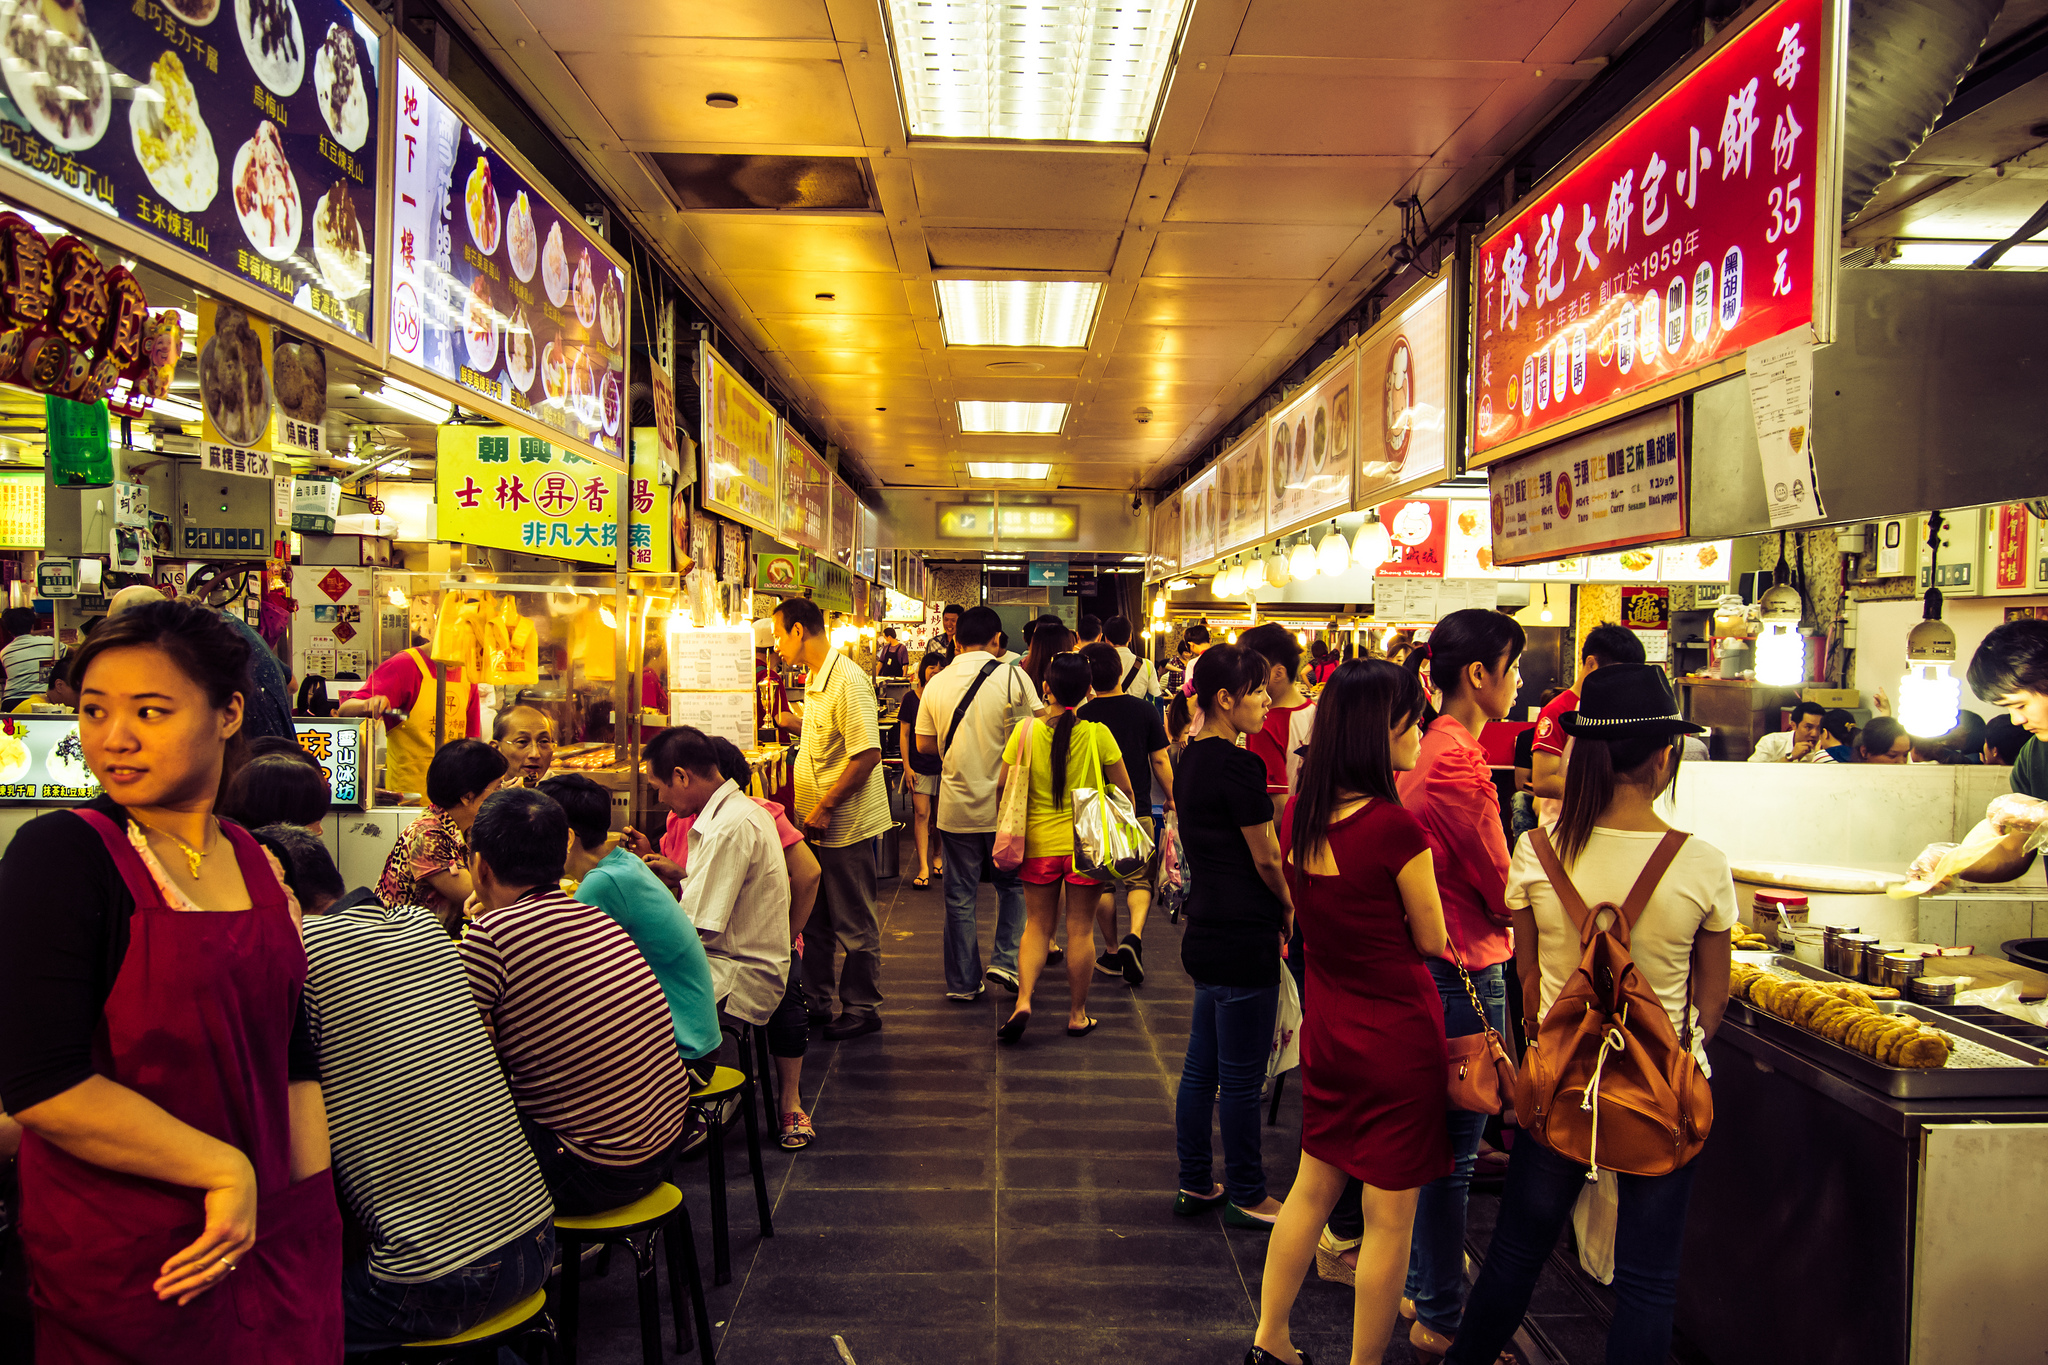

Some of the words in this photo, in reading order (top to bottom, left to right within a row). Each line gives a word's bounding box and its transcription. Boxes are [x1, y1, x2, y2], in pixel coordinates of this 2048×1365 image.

[399, 85, 420, 274] 地下一樓
[1500, 77, 1760, 332] 陳記大餅包小餅
[1599, 229, 1700, 307] 創立於1959年
[1722, 251, 1738, 321] 黑胡椒
[397, 300, 418, 340] 58
[1481, 252, 1496, 388] 地下一樓
[1534, 291, 1591, 342] 五十年老店
[1668, 281, 1683, 347] 咖哩
[1626, 443, 1645, 474] 芝麻
[1647, 432, 1676, 467] 黑胡椒
[1611, 503, 1624, 514] Curry
[336, 729, 357, 800] 雪山冰坊
